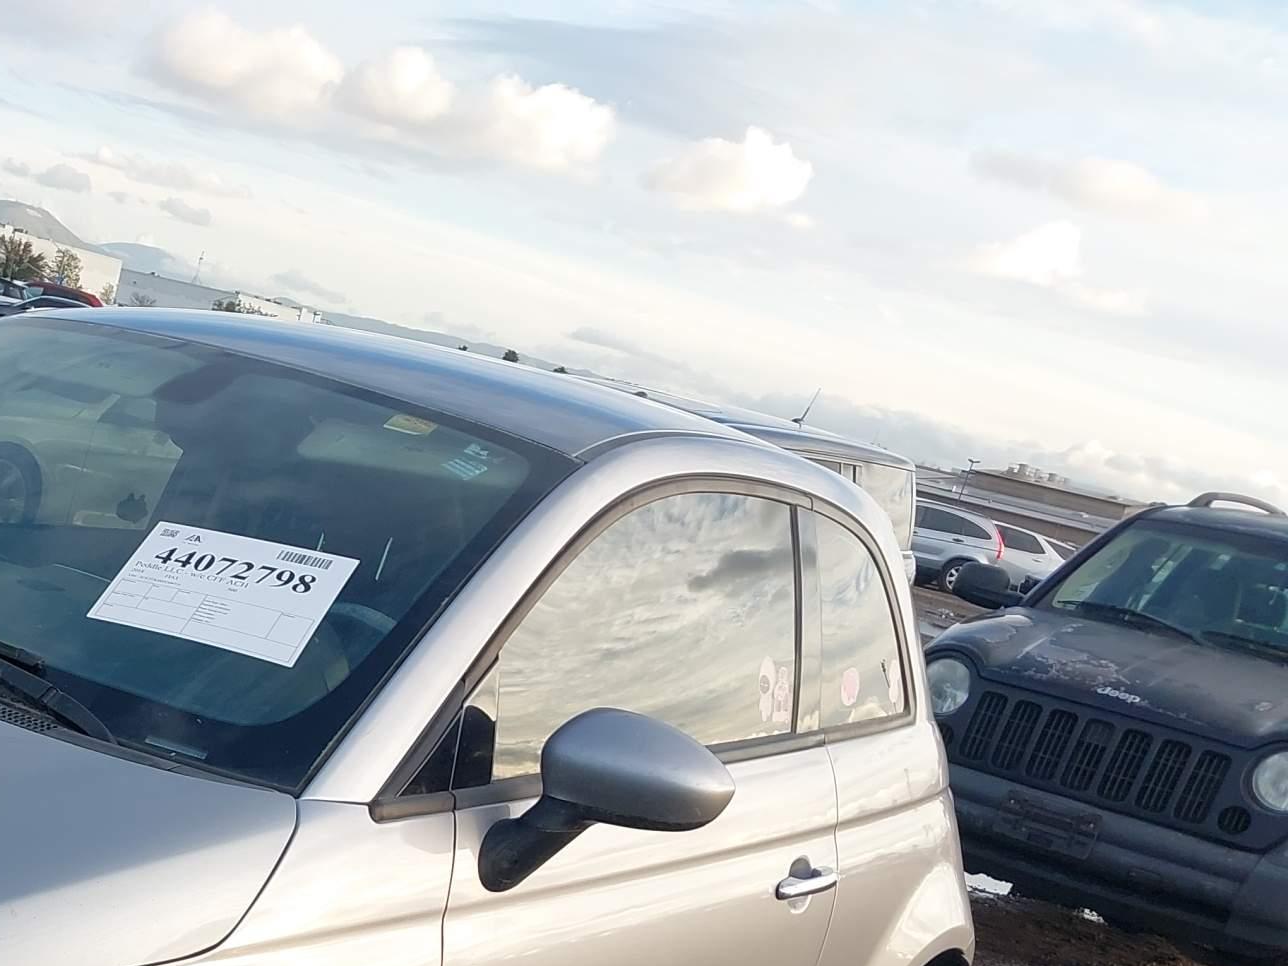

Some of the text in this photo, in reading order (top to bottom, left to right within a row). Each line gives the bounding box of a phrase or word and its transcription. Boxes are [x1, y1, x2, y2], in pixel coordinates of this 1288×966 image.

[135, 560, 162, 571] Peddle
[163, 565, 184, 575] LLC
[155, 547, 317, 593] 44072798
[1096, 686, 1141, 704] Jeep
